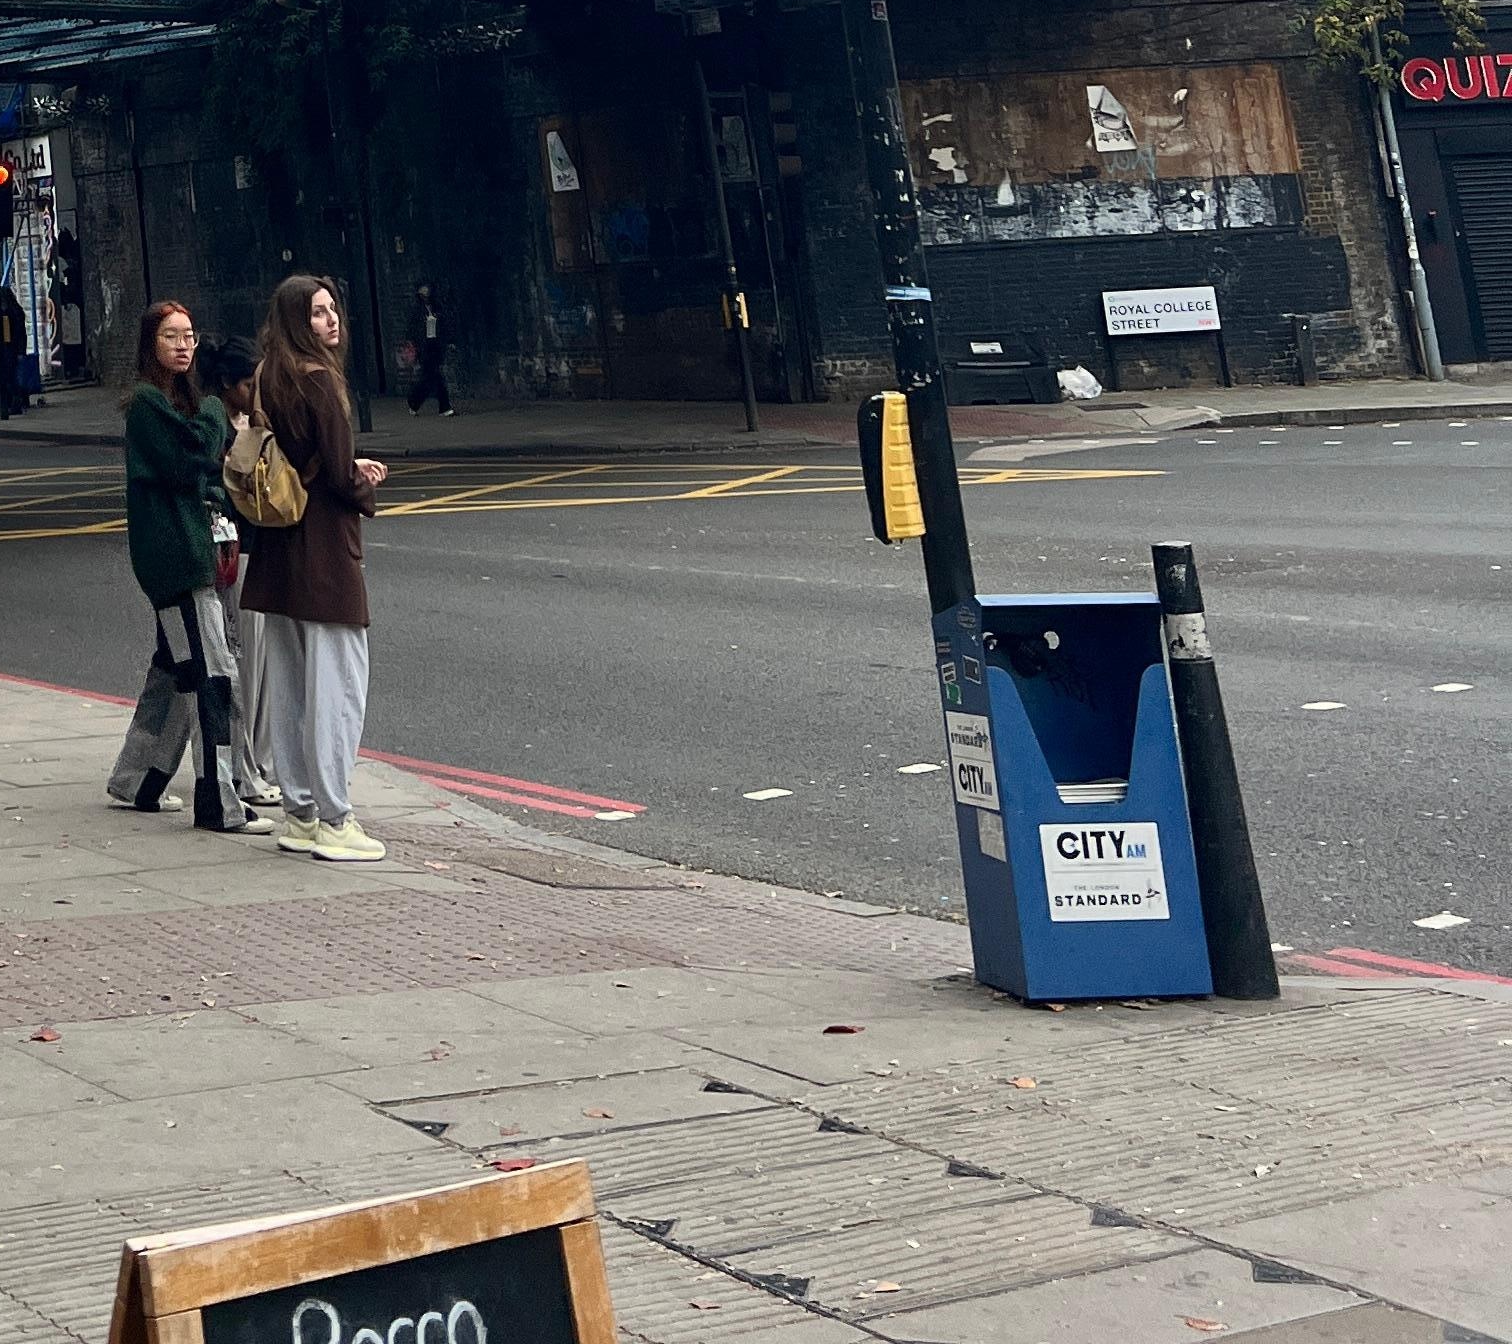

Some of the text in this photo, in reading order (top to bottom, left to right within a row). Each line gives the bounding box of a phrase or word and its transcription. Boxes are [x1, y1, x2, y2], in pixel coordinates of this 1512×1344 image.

[1109, 300, 1213, 316] ROYAL COLLEGE
[1111, 318, 1160, 331] STREET
[958, 762, 985, 795] CITY
[1056, 830, 1146, 860] CITY AM
[1054, 894, 1142, 907] STANDARD
